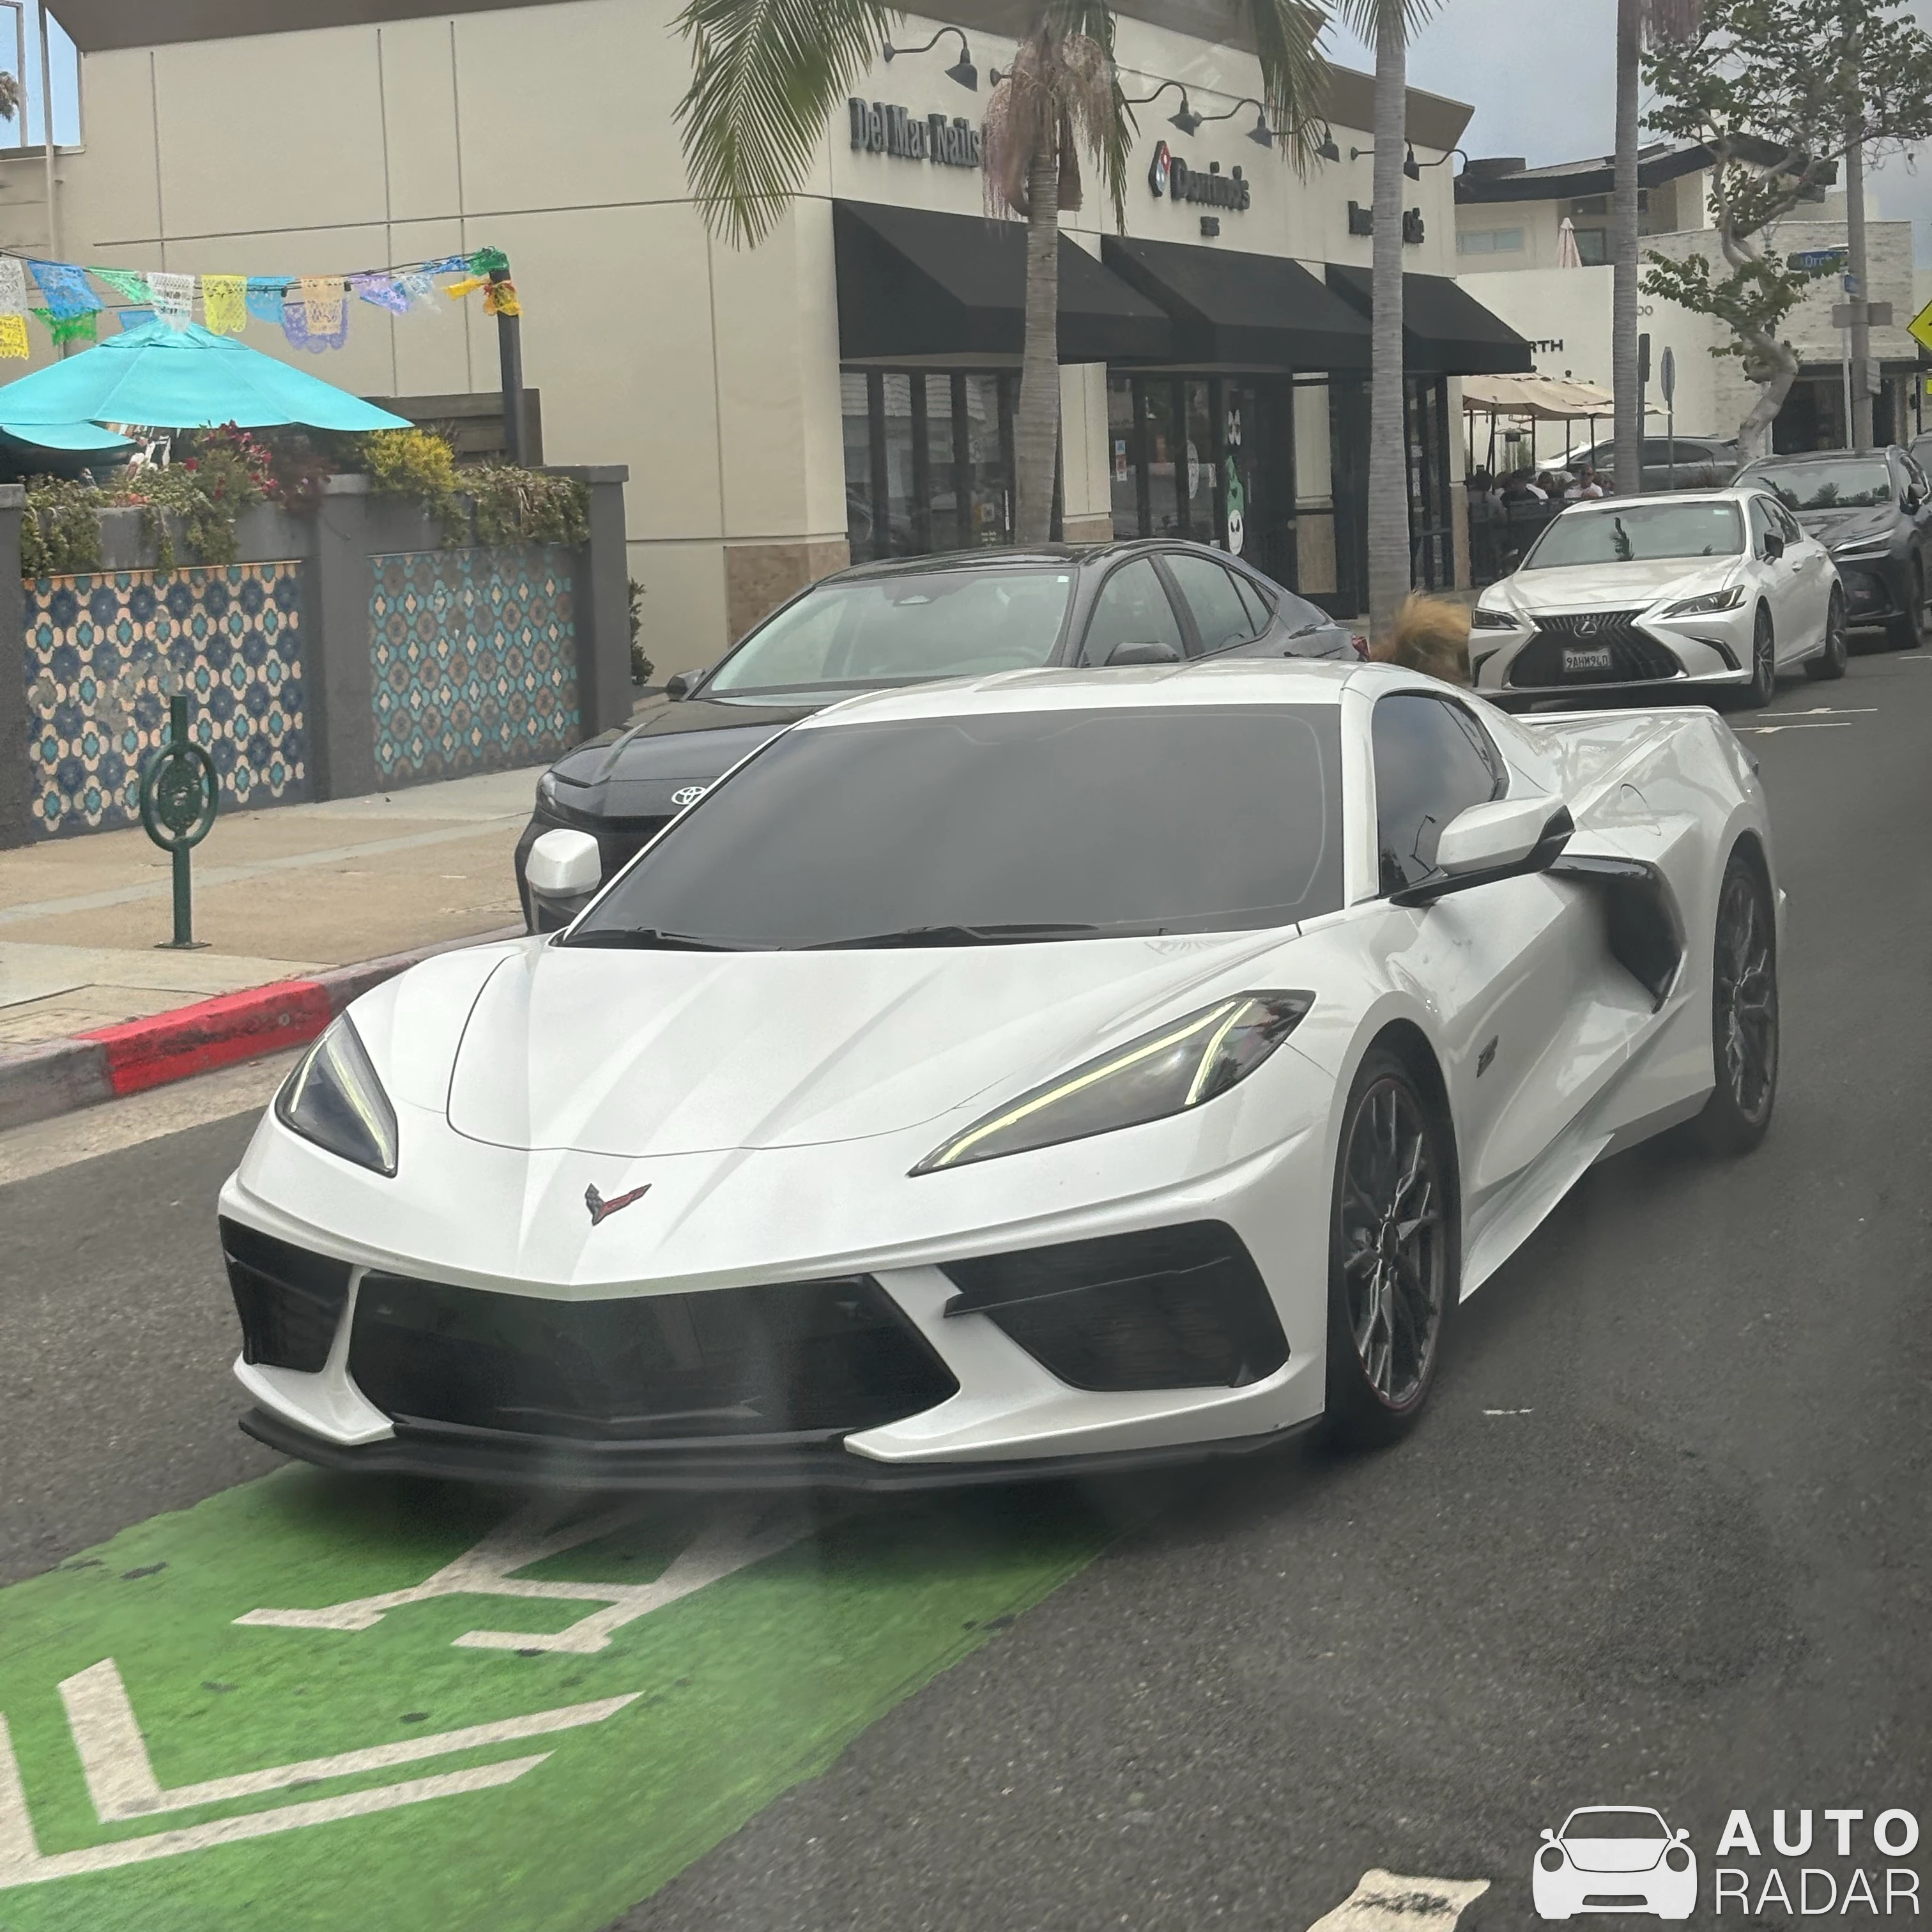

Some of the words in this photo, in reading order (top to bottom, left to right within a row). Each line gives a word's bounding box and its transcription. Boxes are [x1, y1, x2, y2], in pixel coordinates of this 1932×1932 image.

[848, 98, 888, 152] Del
[885, 104, 929, 159] Mar
[928, 113, 983, 167] Nails
